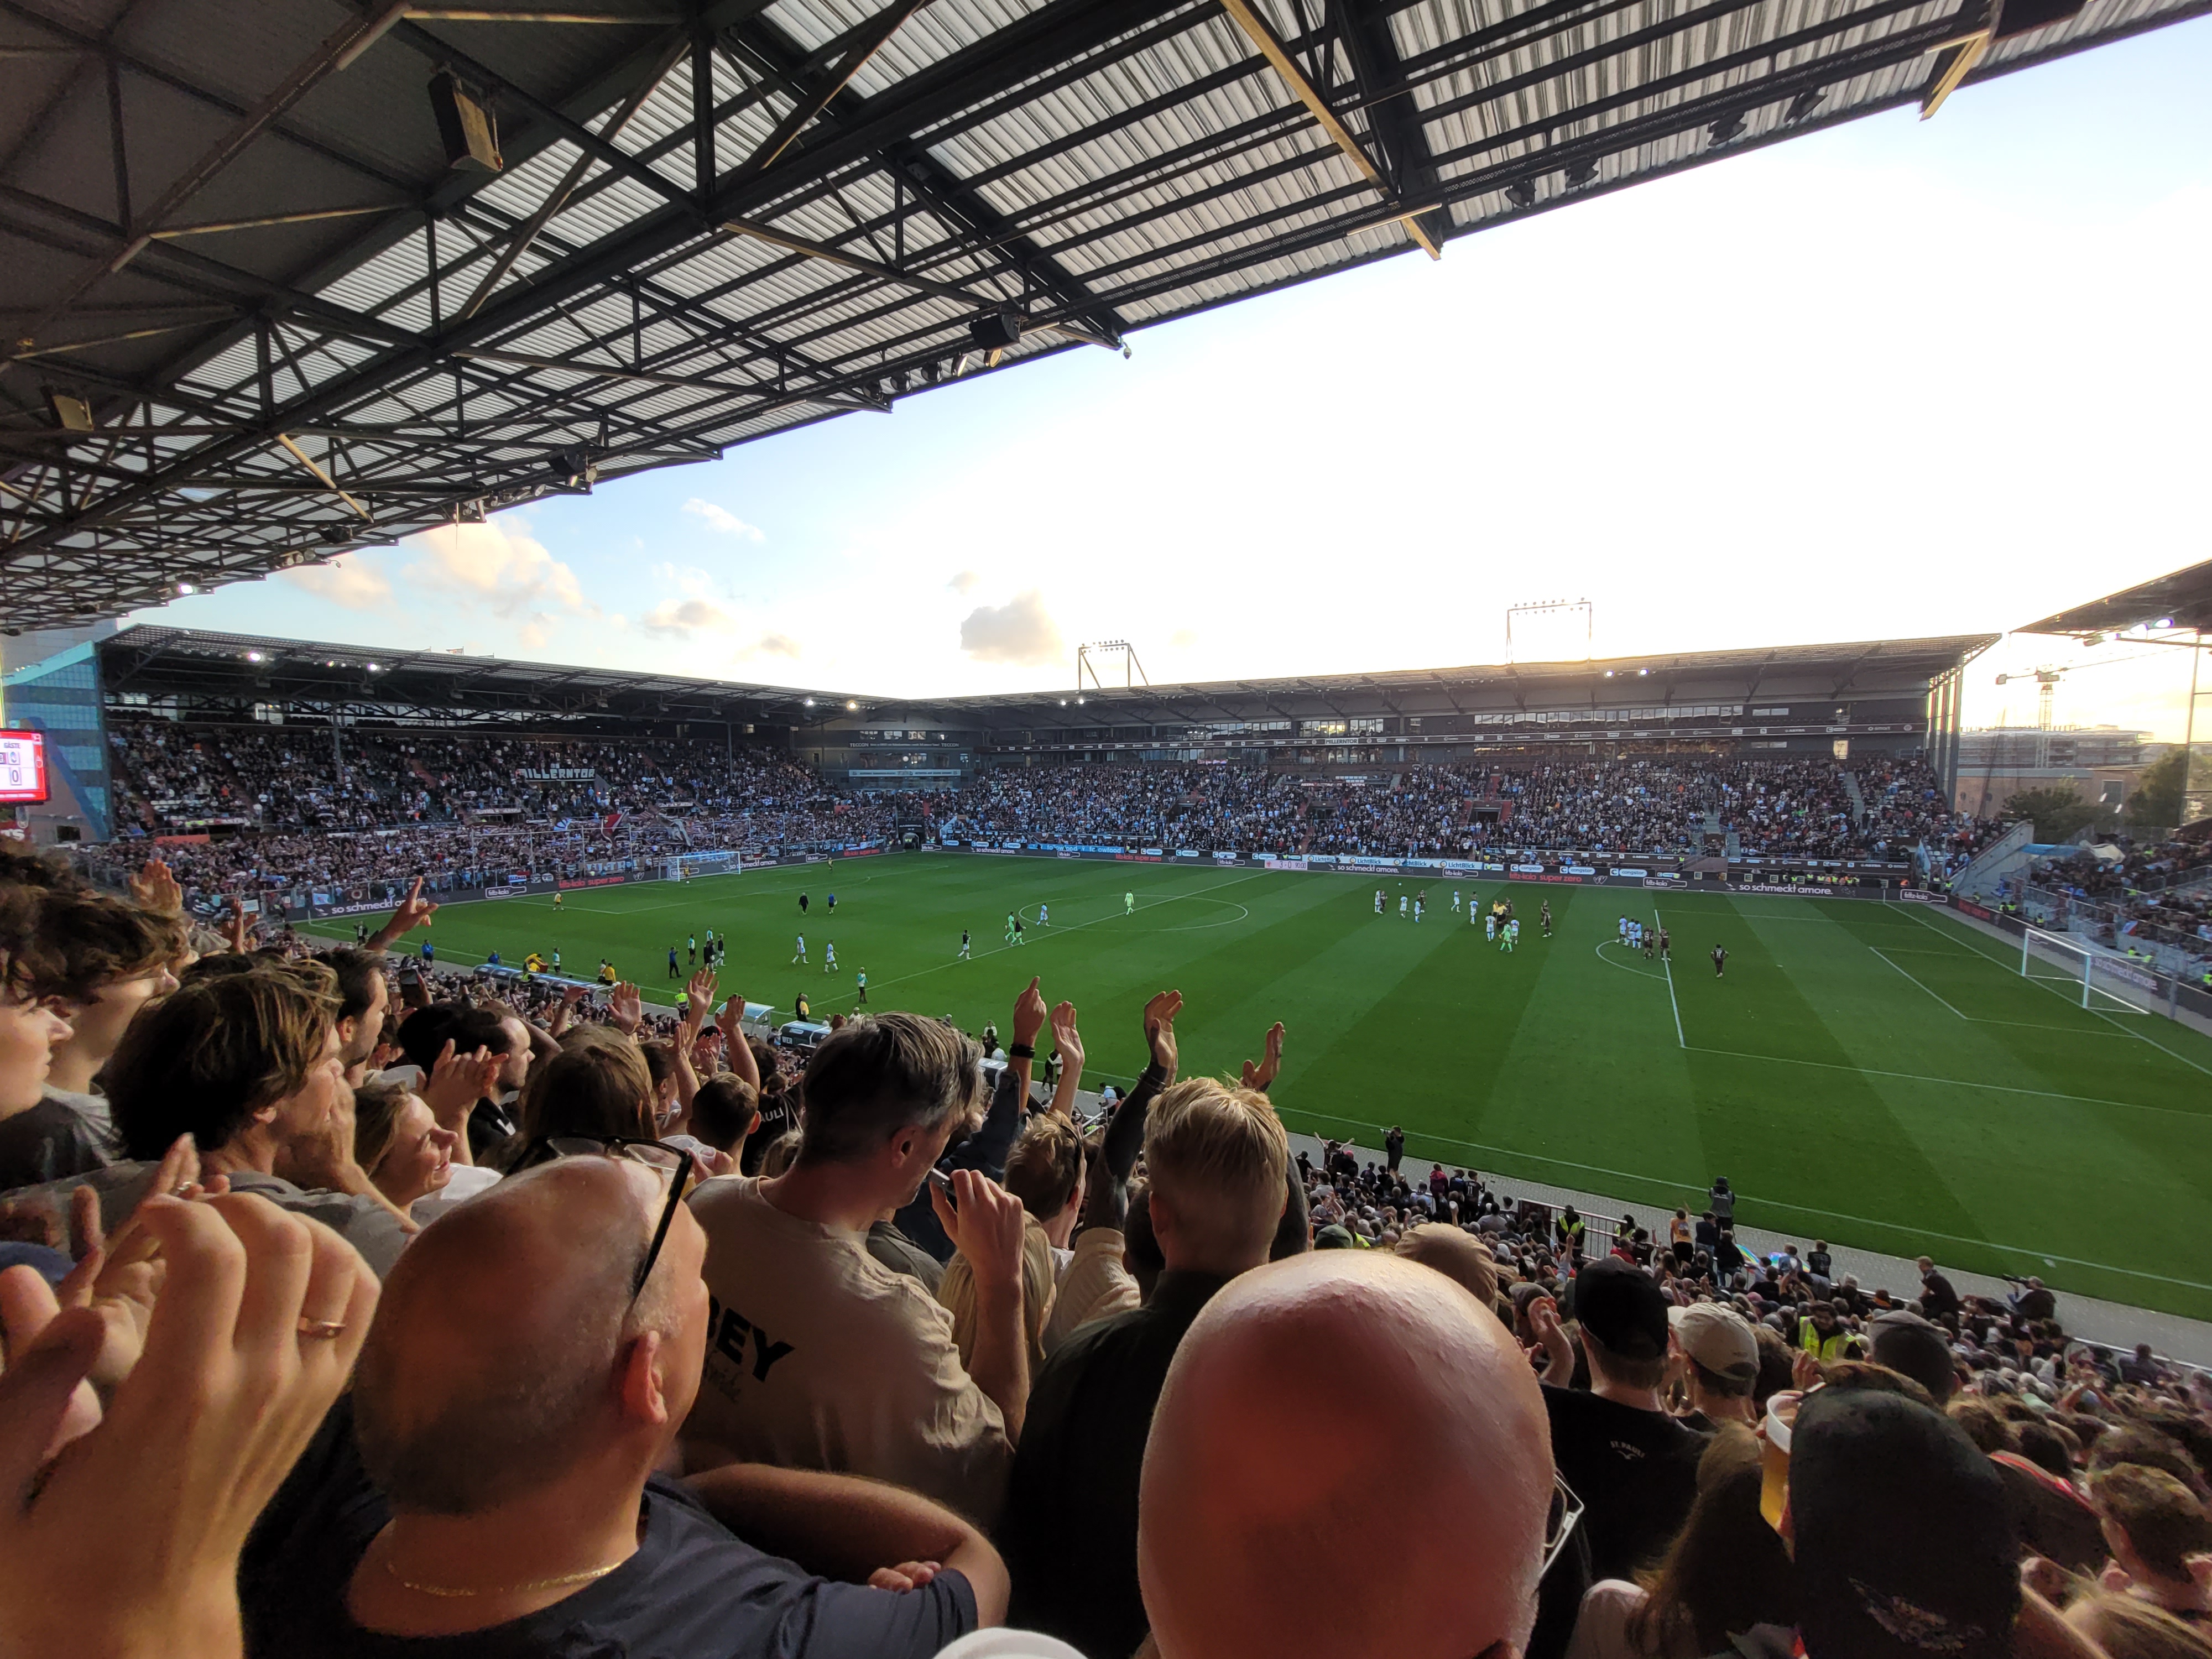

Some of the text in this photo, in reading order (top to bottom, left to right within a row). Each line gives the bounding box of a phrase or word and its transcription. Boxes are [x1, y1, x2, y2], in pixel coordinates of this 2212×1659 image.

[12, 770, 18, 782] 0
[1345, 864, 1376, 872] schmeckt
[1540, 875, 1562, 883] super
[1751, 883, 1796, 892] schmeckt
